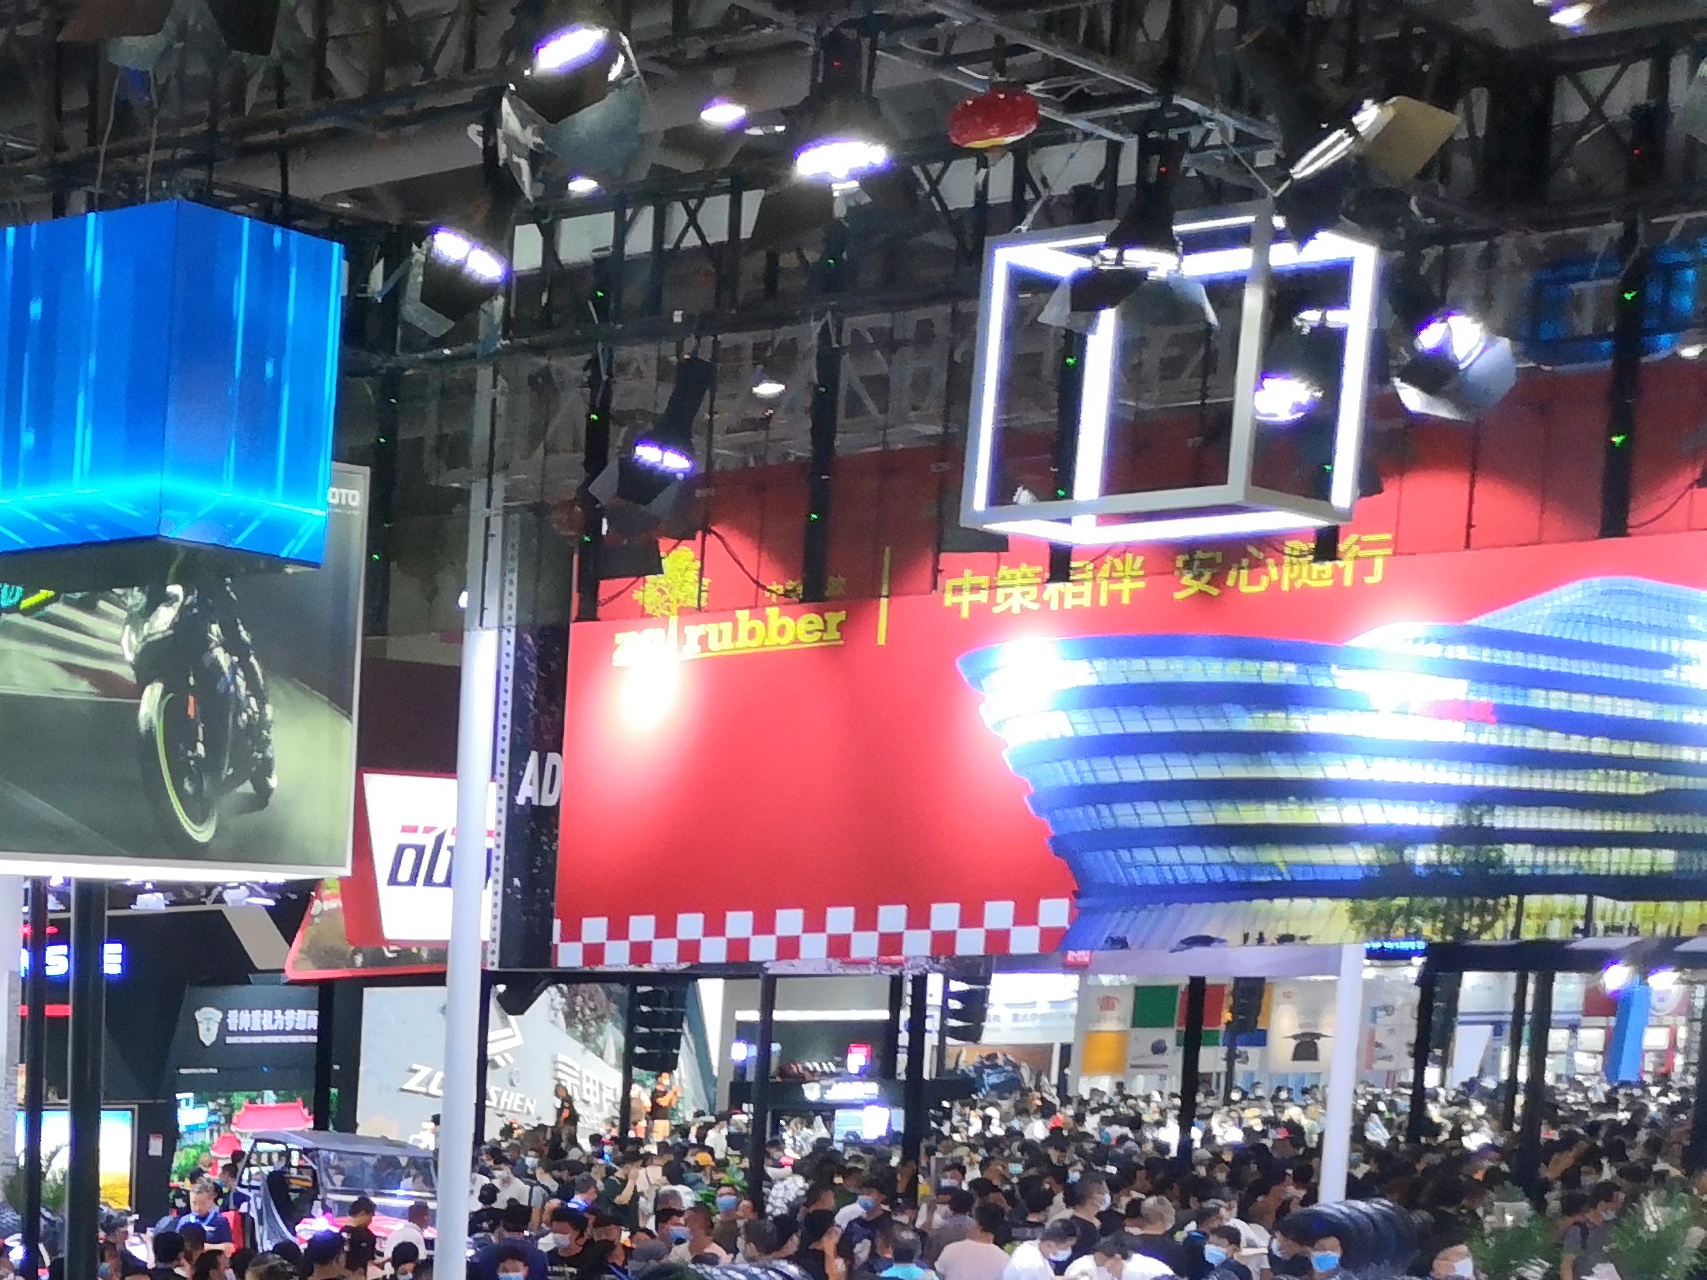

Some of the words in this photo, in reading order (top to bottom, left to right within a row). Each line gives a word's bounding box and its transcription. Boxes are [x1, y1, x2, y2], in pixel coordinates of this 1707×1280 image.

[944, 552, 1145, 618] 中策相伴
[1174, 534, 1393, 600] 安心随行
[682, 607, 847, 653] rubber
